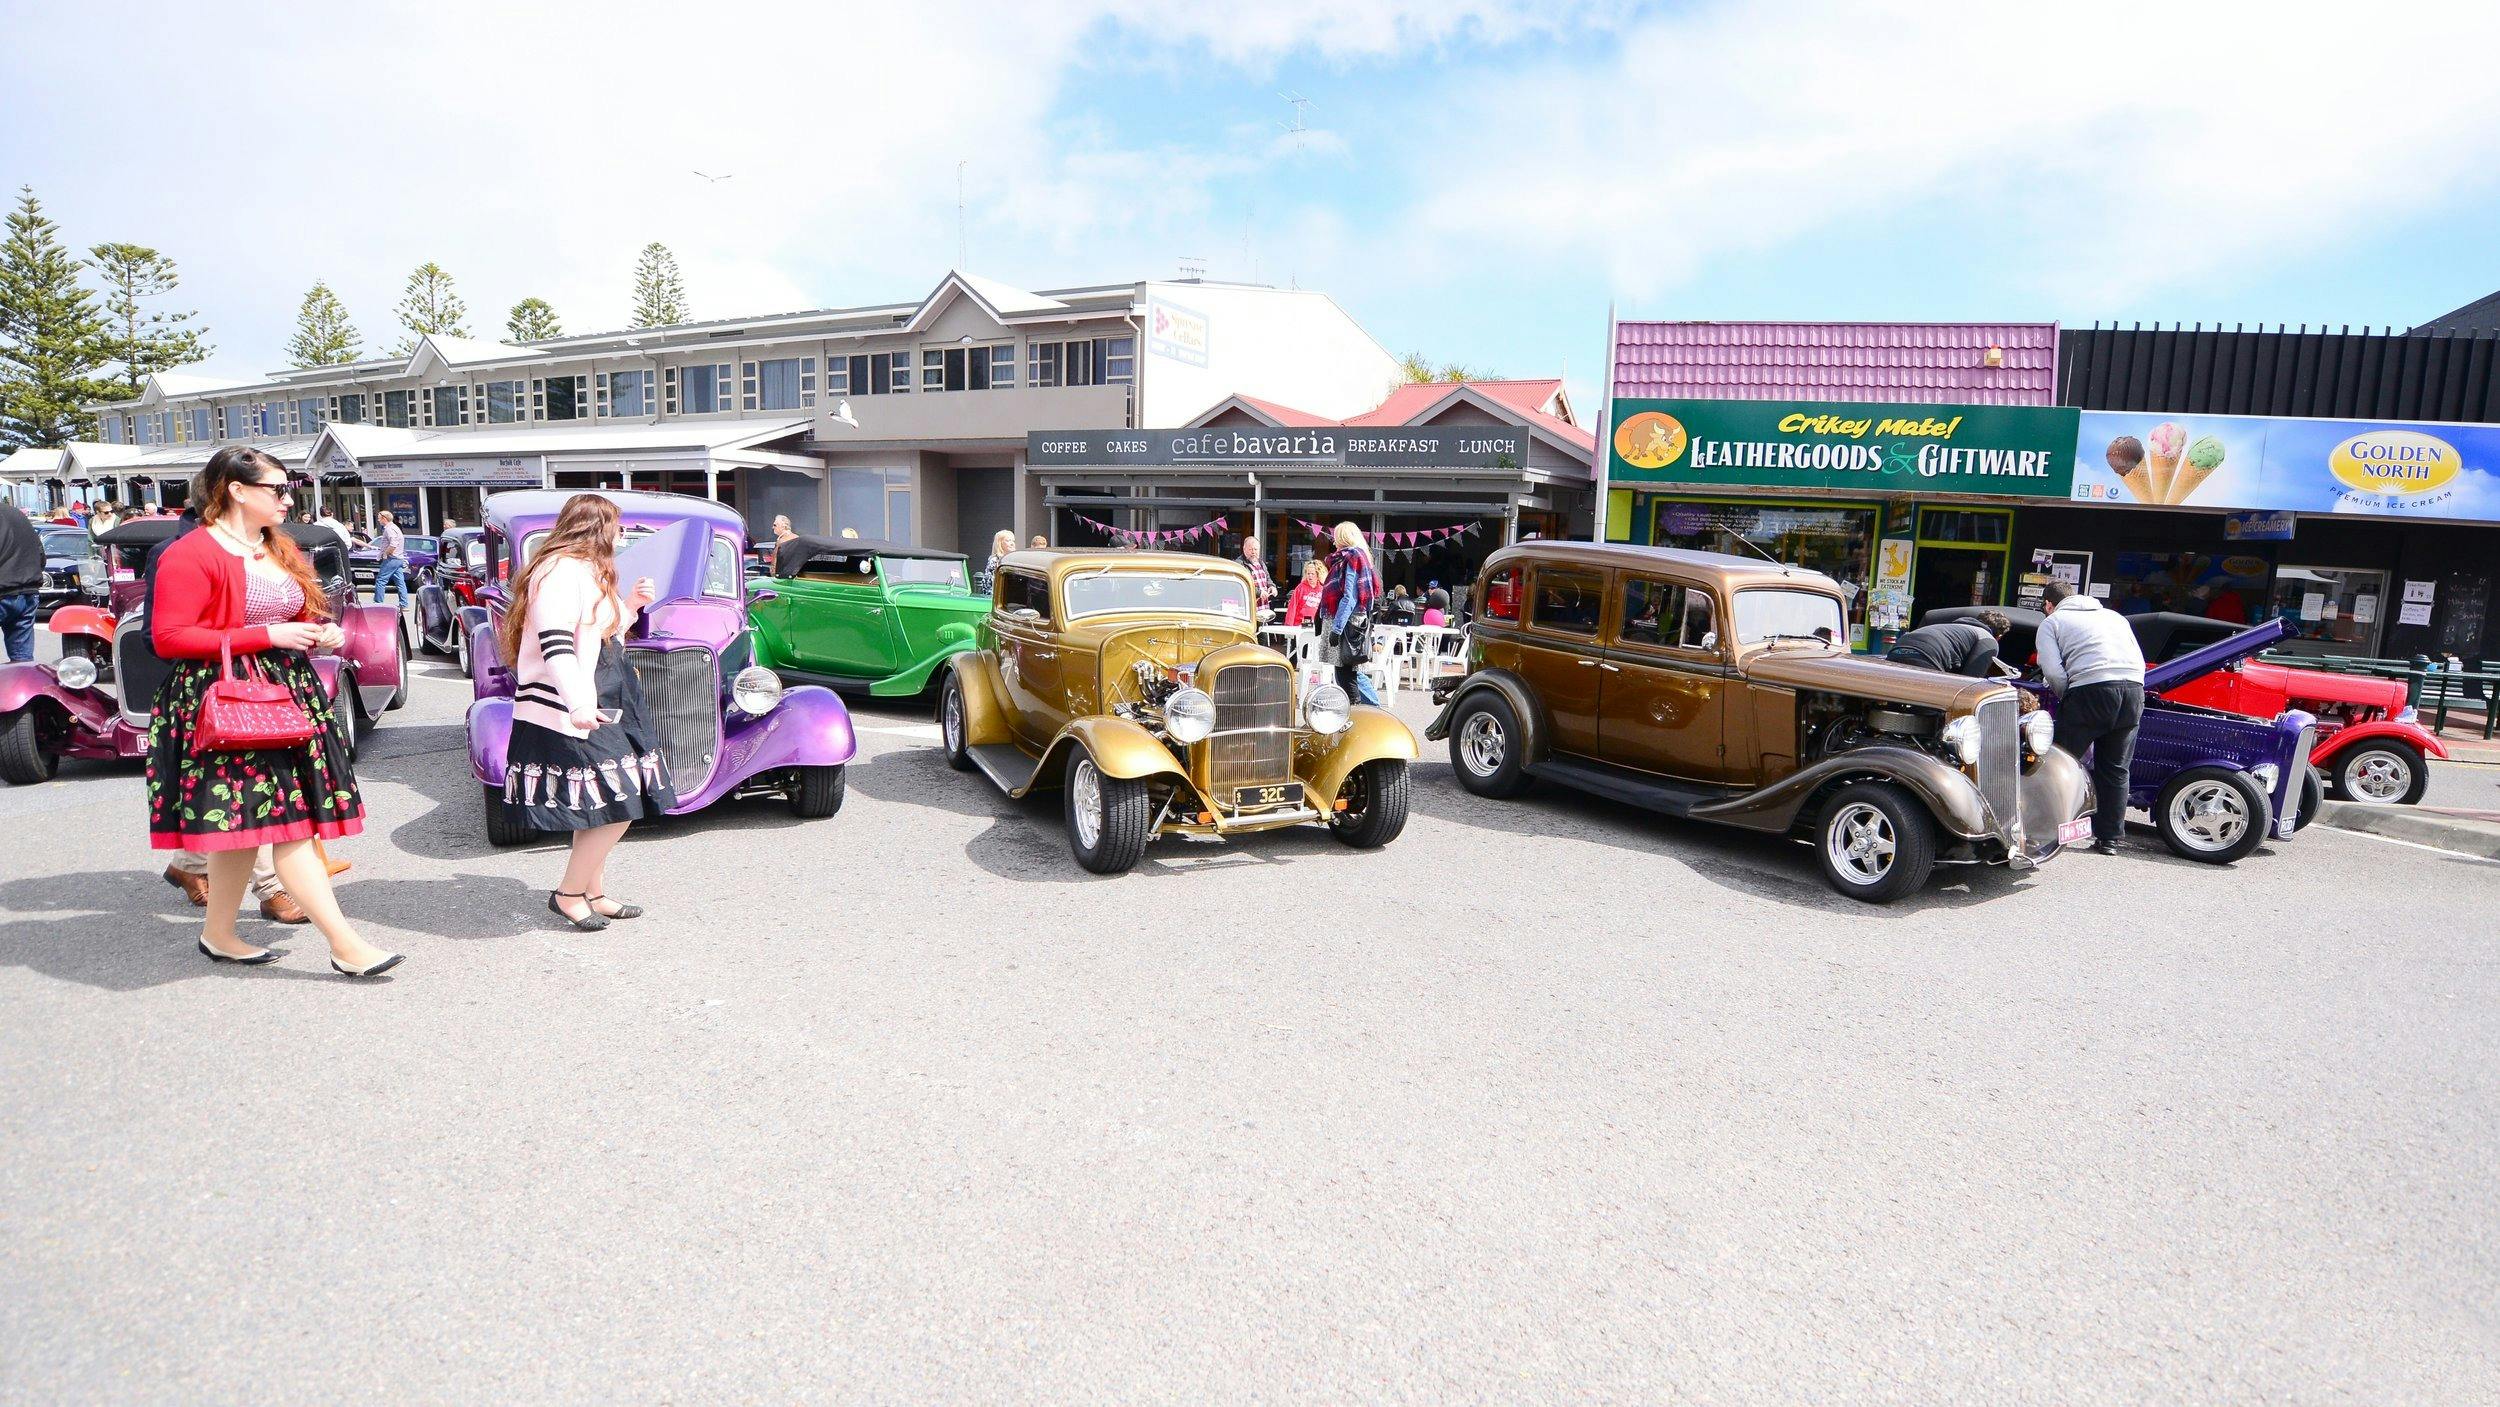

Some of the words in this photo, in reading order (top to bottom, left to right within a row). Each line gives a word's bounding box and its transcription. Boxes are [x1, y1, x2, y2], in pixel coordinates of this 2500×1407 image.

[1778, 412, 1873, 439] Crikey
[1875, 416, 1962, 440] Mate!
[1041, 439, 1087, 454] COFFEE
[1106, 439, 1148, 454] CAKES
[1171, 432, 1228, 455] cafe
[1233, 430, 1336, 455] bavaria
[1347, 438, 1439, 454] BREAKFAST
[1458, 438, 1516, 454] LUNCH
[2350, 440, 2443, 462] GOLDEN
[1690, 436, 1883, 472] LEATHERGOODS
[1881, 441, 1918, 475] &
[1918, 444, 2051, 478] GIFTWARE
[2362, 463, 2431, 480] NORTH
[2329, 486, 2381, 509] PREMIUM
[2386, 501, 2406, 510] ICE
[2411, 490, 2453, 509] CREAM
[1259, 787, 1285, 803] 32C
